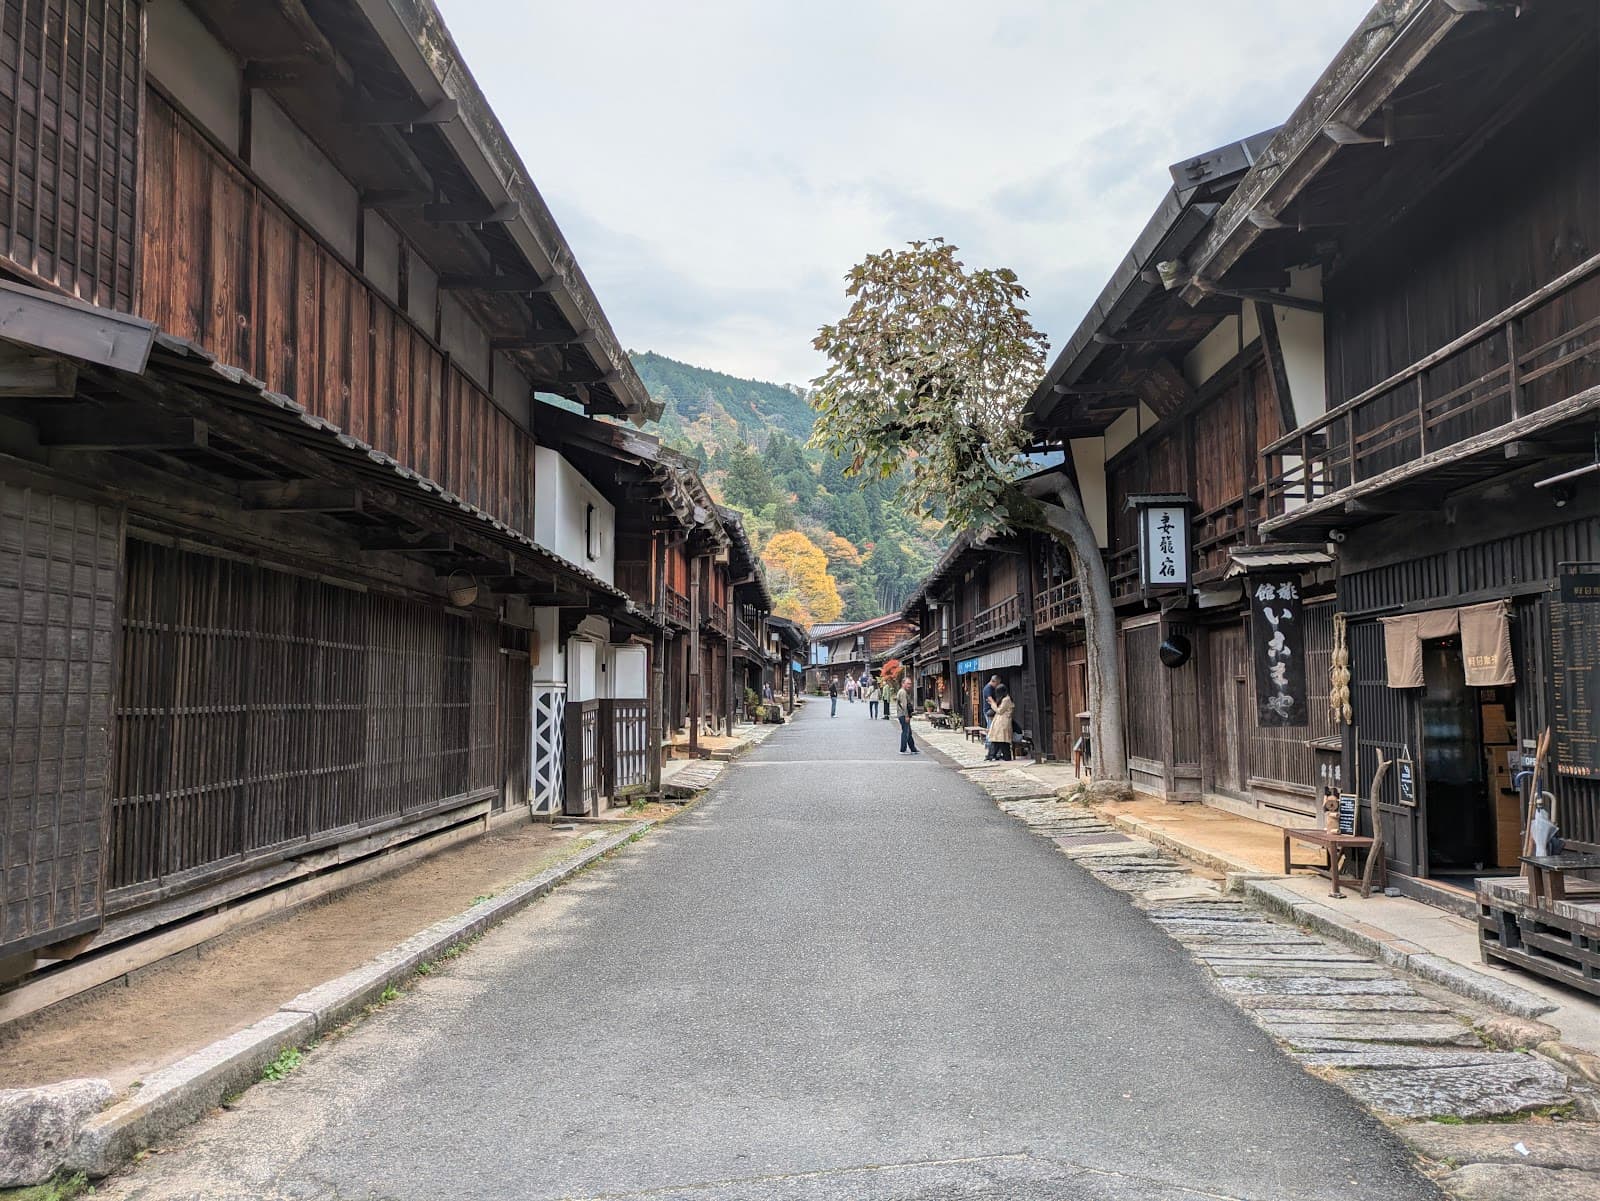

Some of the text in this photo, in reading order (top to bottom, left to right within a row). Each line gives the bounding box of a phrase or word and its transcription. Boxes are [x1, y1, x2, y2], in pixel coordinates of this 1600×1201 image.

[1157, 511, 1176, 577] 妻籠宿
[1525, 756, 1537, 766] OPE
